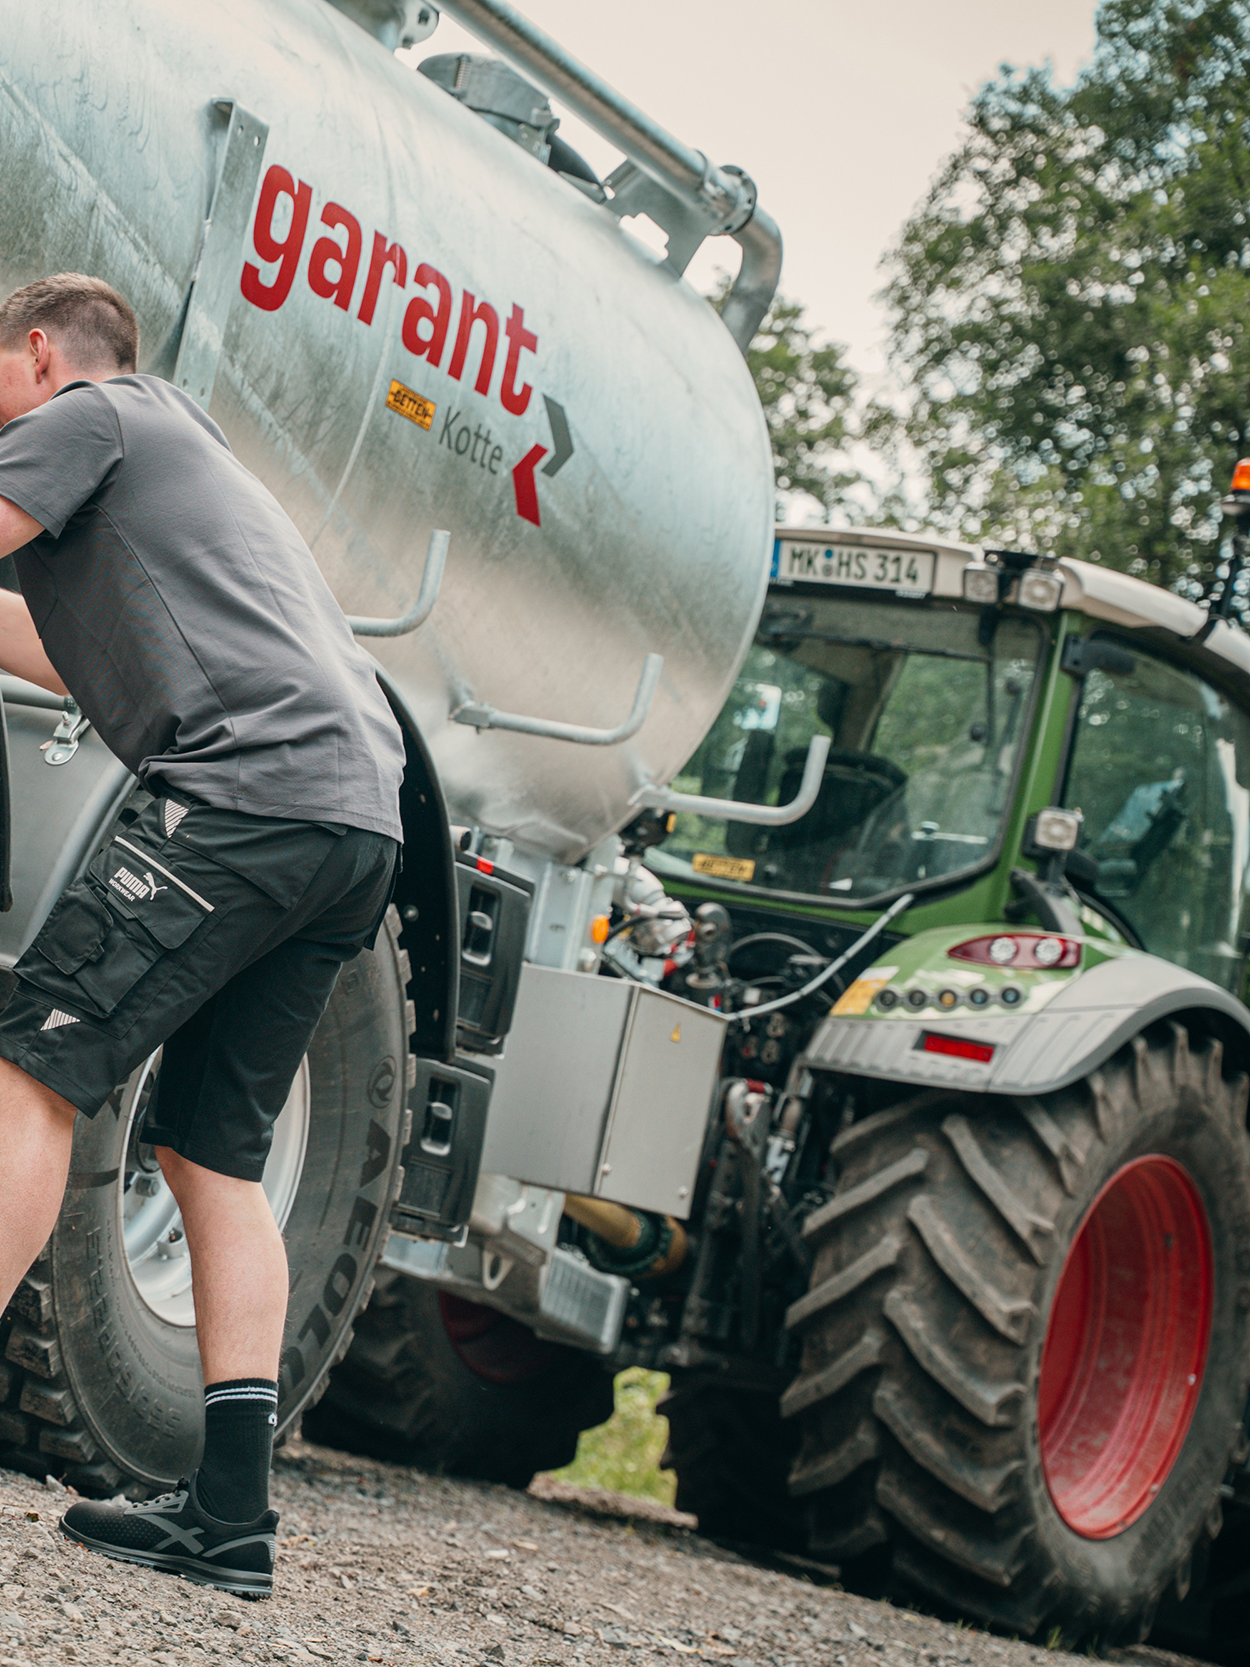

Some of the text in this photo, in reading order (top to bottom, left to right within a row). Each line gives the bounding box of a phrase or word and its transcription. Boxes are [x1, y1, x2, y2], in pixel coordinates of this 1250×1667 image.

[240, 163, 539, 416] garant
[438, 406, 505, 476] Kotte
[788, 545, 919, 584] MK HS 314
[108, 877, 136, 902] WORKWEAR
[114, 867, 149, 899] PUMA
